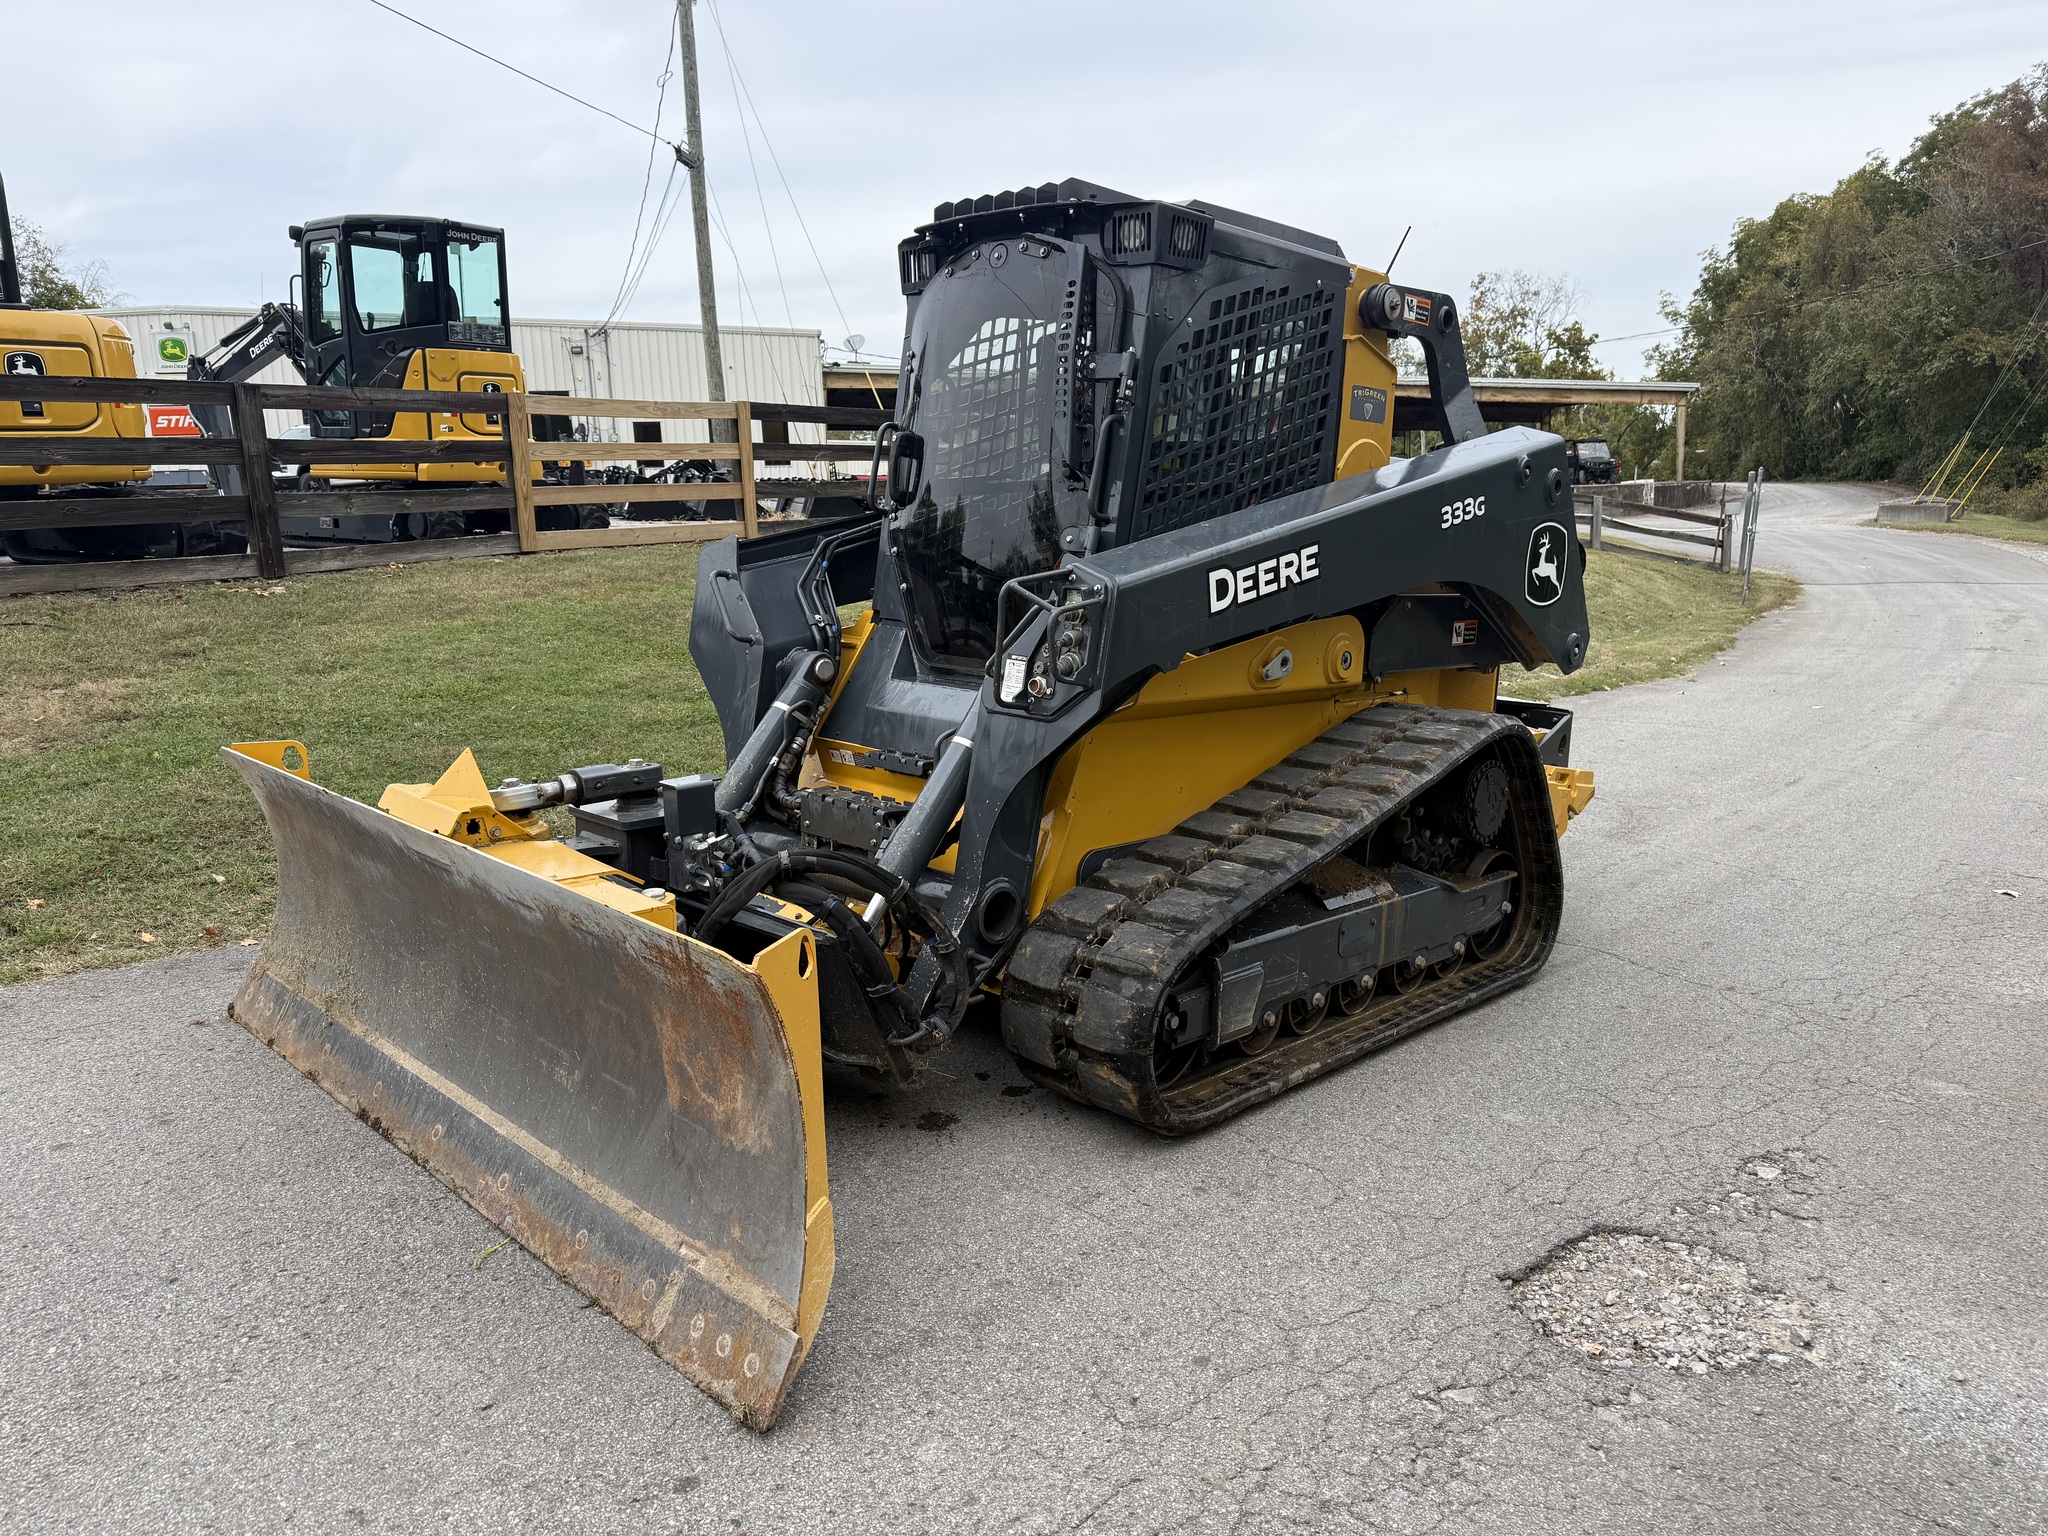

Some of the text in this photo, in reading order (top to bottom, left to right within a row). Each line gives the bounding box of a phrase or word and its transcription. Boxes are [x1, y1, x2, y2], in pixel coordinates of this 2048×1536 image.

[446, 229, 498, 243] JOHN DEERE
[249, 333, 274, 359] DEERE
[1353, 388, 1386, 403] TRIGREEN
[155, 415, 195, 428] STIH
[1441, 495, 1486, 529] 333G
[1208, 544, 1320, 614] DEERE
